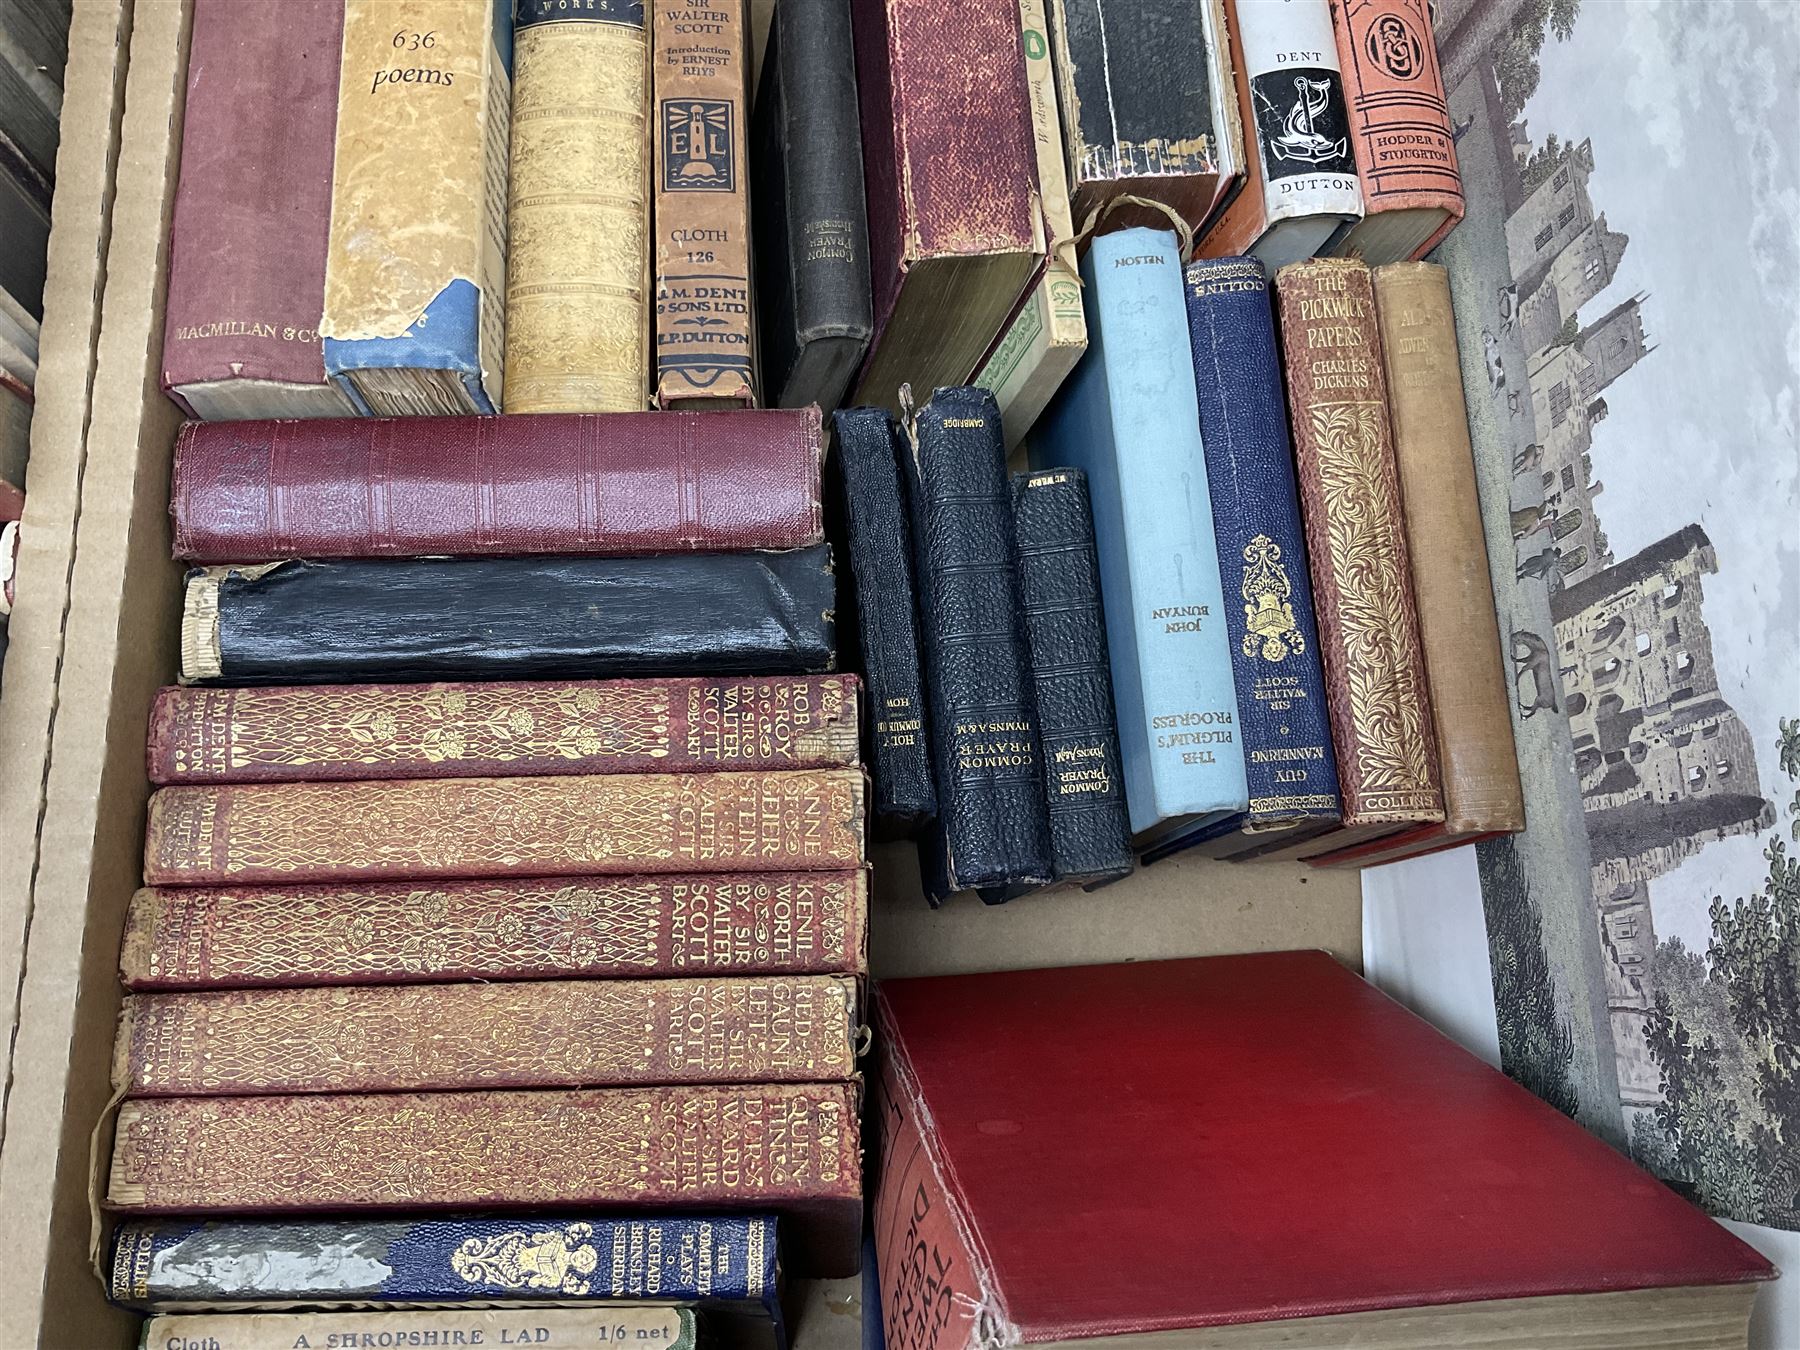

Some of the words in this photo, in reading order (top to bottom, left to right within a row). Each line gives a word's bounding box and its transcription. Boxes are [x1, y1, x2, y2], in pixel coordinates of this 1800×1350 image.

[687, 0, 710, 8] SIR
[667, 10, 730, 23] WALTER
[392, 28, 438, 51] 636
[674, 23, 723, 35] SCOTT
[667, 45, 731, 56] Introduction
[667, 56, 679, 65] by
[682, 55, 730, 66] ERNEST
[1276, 51, 1322, 63] DENT
[371, 68, 454, 95] poems
[682, 66, 716, 77] RHYS
[1031, 80, 1049, 144] Wrdsworth
[1376, 135, 1433, 148] HODDER
[1379, 149, 1449, 162] STOUGHTON
[1280, 179, 1354, 194] DUTTON
[671, 229, 729, 242] CLOTH
[687, 251, 714, 263] 126
[1115, 255, 1165, 268] NELSON
[694, 287, 747, 300] DENT
[1195, 281, 1265, 297] COLLINS
[1315, 277, 1347, 292] THE
[668, 301, 711, 313] SONS
[714, 302, 748, 315] LTD.
[1300, 297, 1365, 321] PICKWICK
[176, 321, 278, 340] MACMILLAN
[282, 327, 296, 341] &
[1307, 326, 1362, 349] PAPERS
[1312, 359, 1367, 375] CHARLES
[1313, 375, 1369, 390] DICKENS
[943, 418, 984, 429] CAMBRIDGE
[1152, 605, 1210, 620] BUNYAN
[1165, 618, 1202, 634] JOHN
[1254, 688, 1307, 700] WALTER
[1255, 677, 1299, 689] SCOTT
[742, 686, 755, 713] BY
[793, 683, 810, 726] ROB
[886, 698, 909, 708] HOW
[1270, 700, 1291, 711] SIR
[704, 687, 720, 760] SCOTT
[723, 686, 739, 760] WALTER
[741, 712, 755, 742] SIR
[988, 721, 1030, 732] HYMNS
[1153, 712, 1233, 729] PROGRESS
[687, 712, 701, 760] BART
[775, 710, 792, 758] ROY
[1158, 731, 1233, 749] PILGRIM'S
[959, 742, 1031, 756] PRAYER
[1182, 750, 1216, 765] THE
[1251, 746, 1324, 763] MANNERING
[959, 755, 1032, 770] COMMON
[1059, 762, 1107, 782] PRAYER
[1060, 776, 1110, 795] COMMON
[1274, 769, 1308, 783] GUY
[784, 778, 800, 808] OF
[1365, 795, 1434, 810] COLLINS
[679, 777, 696, 858] SCOTT
[700, 778, 715, 860] WALTER
[738, 777, 757, 857] STEIN
[803, 779, 822, 857] ANNE
[718, 820, 735, 857] SIR
[736, 884, 751, 912] BY
[671, 885, 688, 944] BART
[689, 884, 709, 965] SCOTT
[713, 884, 731, 966] WALTER
[773, 884, 792, 965] WORTH
[735, 927, 751, 964] SIR
[730, 985, 746, 1013] BY
[749, 984, 768, 1034] LET
[669, 987, 685, 1040] BART
[687, 984, 706, 1071] SCOTT
[709, 985, 726, 1072] WALTER
[729, 1029, 744, 1071] SIR
[702, 1099, 718, 1128] BY
[769, 1098, 786, 1149] TIN
[660, 1100, 677, 1190] SCOTT
[682, 1099, 697, 1190] WALTER
[722, 1100, 740, 1187] WARD
[702, 1145, 718, 1188] SIR
[612, 1226, 626, 1297] SHERIDAN
[630, 1222, 644, 1297] BRINSLEY
[647, 1226, 662, 1294] RICHARD
[680, 1233, 694, 1285] PLAYS
[698, 1223, 712, 1296] COMPLETE
[717, 1244, 730, 1275] THE
[166, 1337, 221, 1350] Cloth
[293, 1333, 311, 1349] A
[326, 1329, 484, 1349] SHROPSHIRE
[500, 1327, 550, 1344] LAD
[599, 1325, 627, 1345] 1/6
[636, 1325, 670, 1340] net
